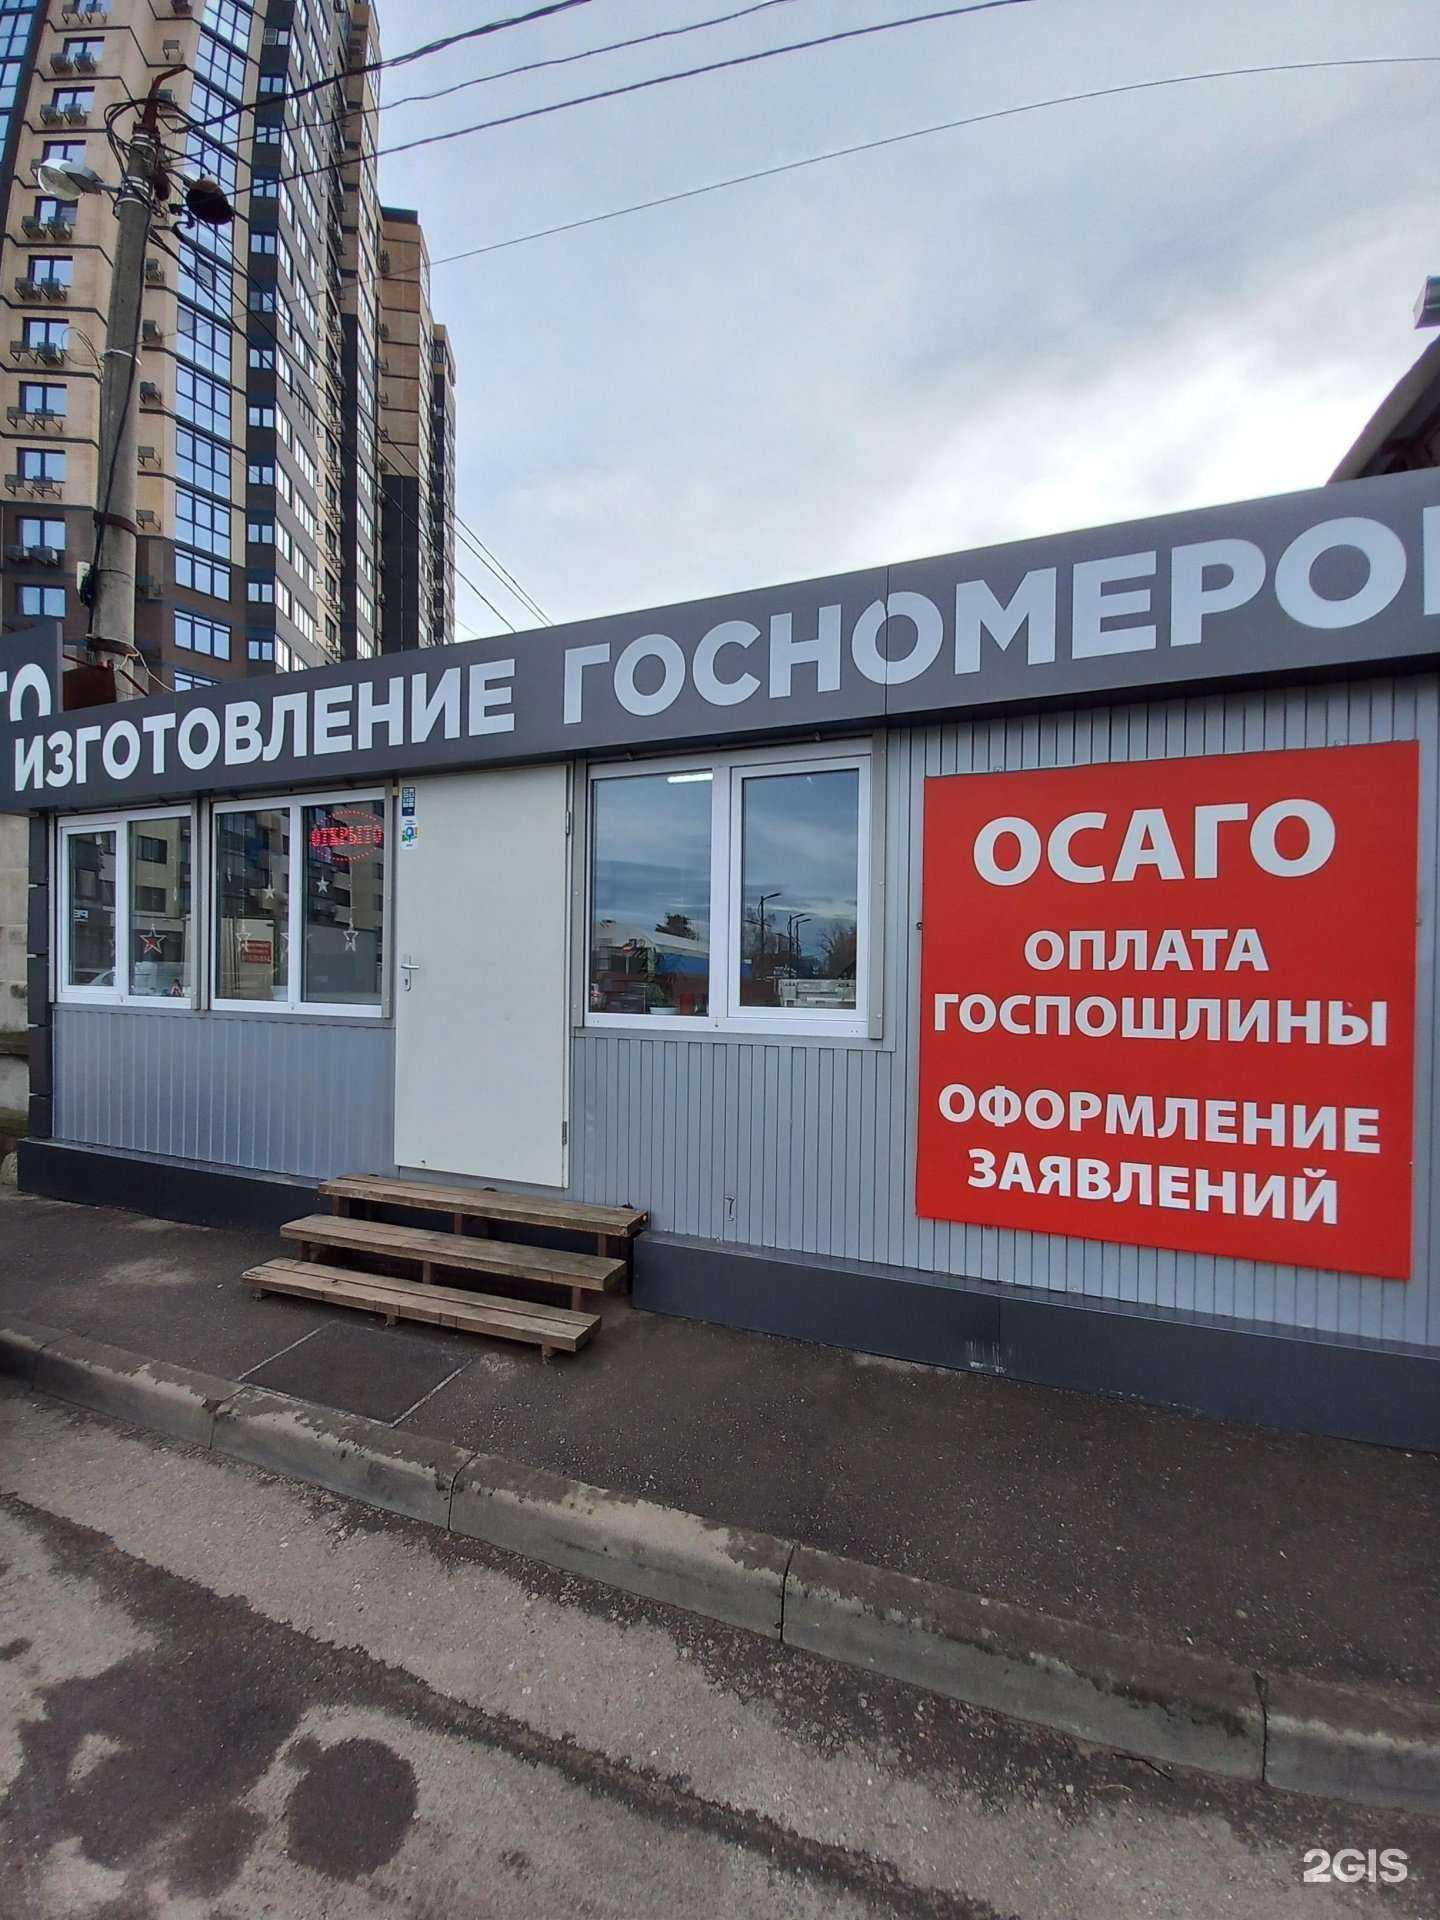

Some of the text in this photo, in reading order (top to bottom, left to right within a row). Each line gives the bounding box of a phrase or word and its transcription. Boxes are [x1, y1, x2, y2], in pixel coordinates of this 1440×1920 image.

[14, 505, 1440, 792] ИЗГОТОВЛЕНИЕ ГОСНОМЕРО
[0, 663, 52, 722] О
[311, 824, 384, 847] ОТКРЫТО
[973, 798, 1336, 886] ОСАГО
[1024, 928, 1269, 972] ОПЛАТА
[934, 993, 1387, 1046] ГОСПОШЛИНЫ
[938, 1083, 1381, 1154] ОФОРМЛЕНИЕ
[967, 1148, 1338, 1225] ЗАЯВЛЕНИЙ
